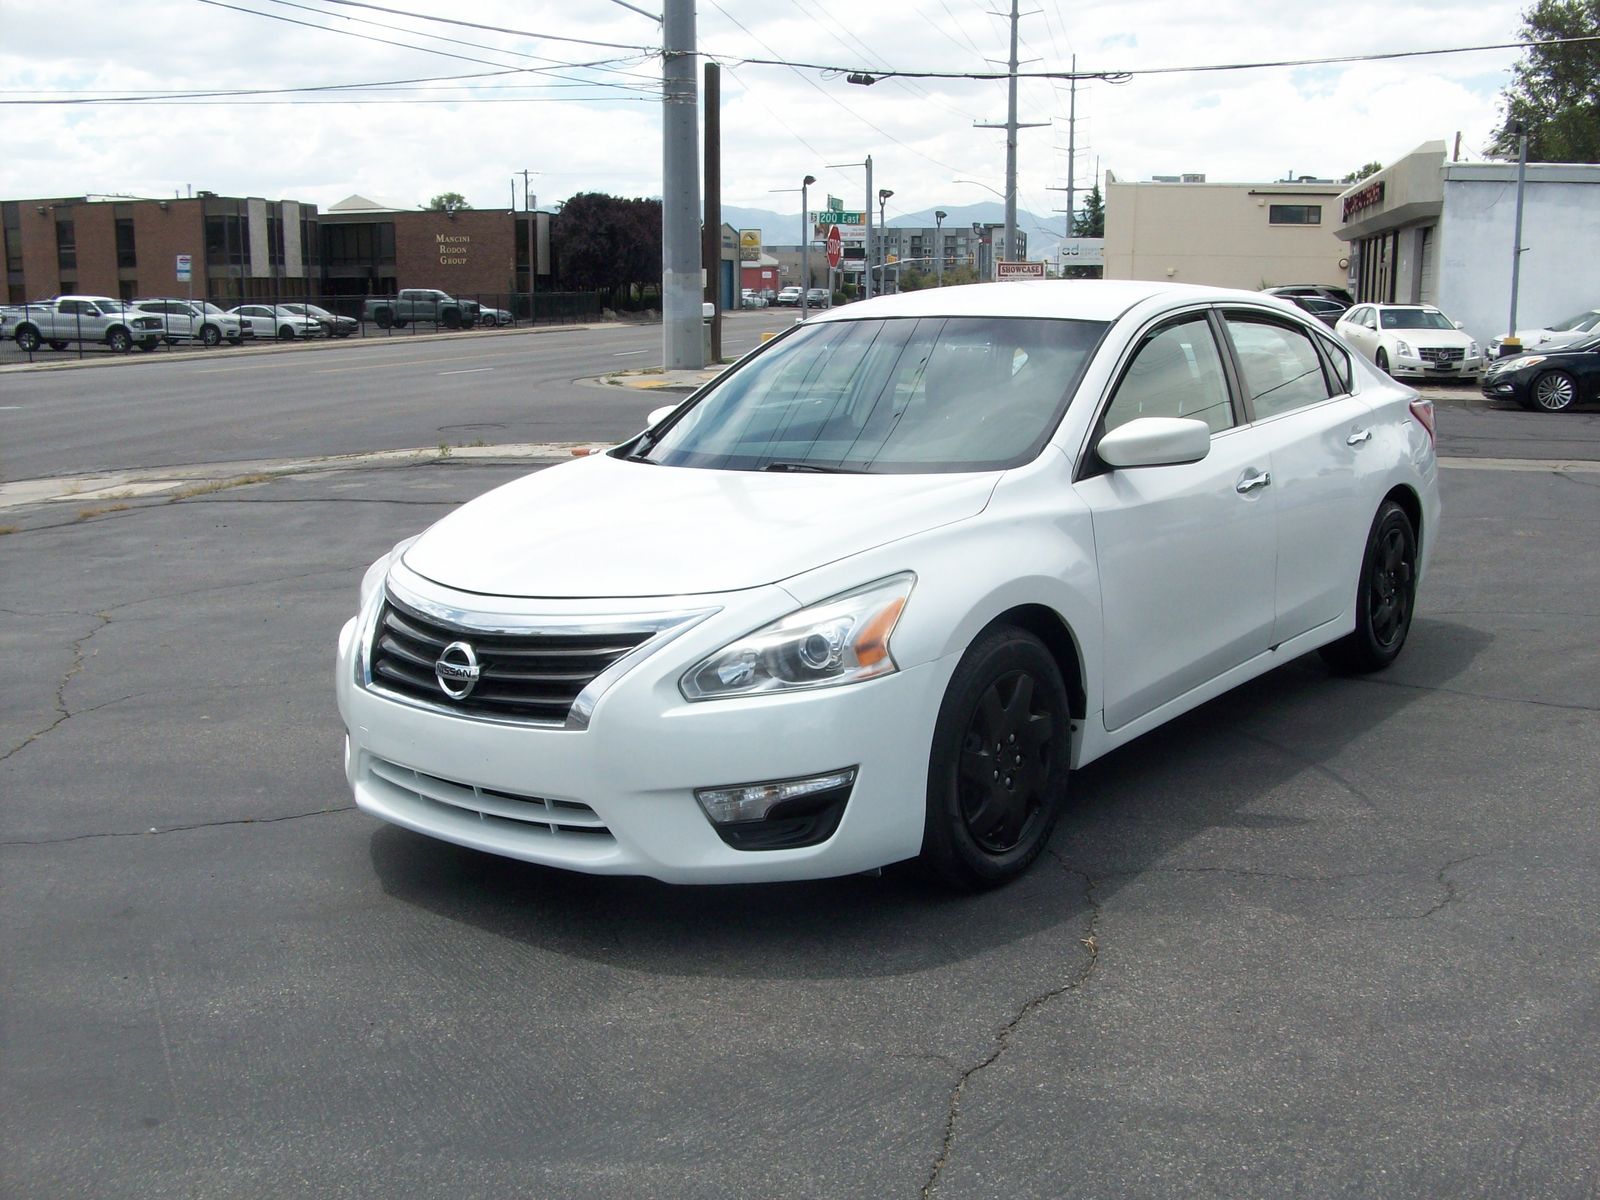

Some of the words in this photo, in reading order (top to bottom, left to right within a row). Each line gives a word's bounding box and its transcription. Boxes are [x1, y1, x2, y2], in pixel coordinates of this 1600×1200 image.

[820, 213, 838, 223] 200
[842, 213, 859, 224] East
[436, 233, 470, 243] MANCINI
[828, 239, 841, 255] STOP
[440, 256, 467, 265] GROUP
[1001, 265, 1040, 274] SHOWCASE
[437, 663, 472, 678] NISSAN
